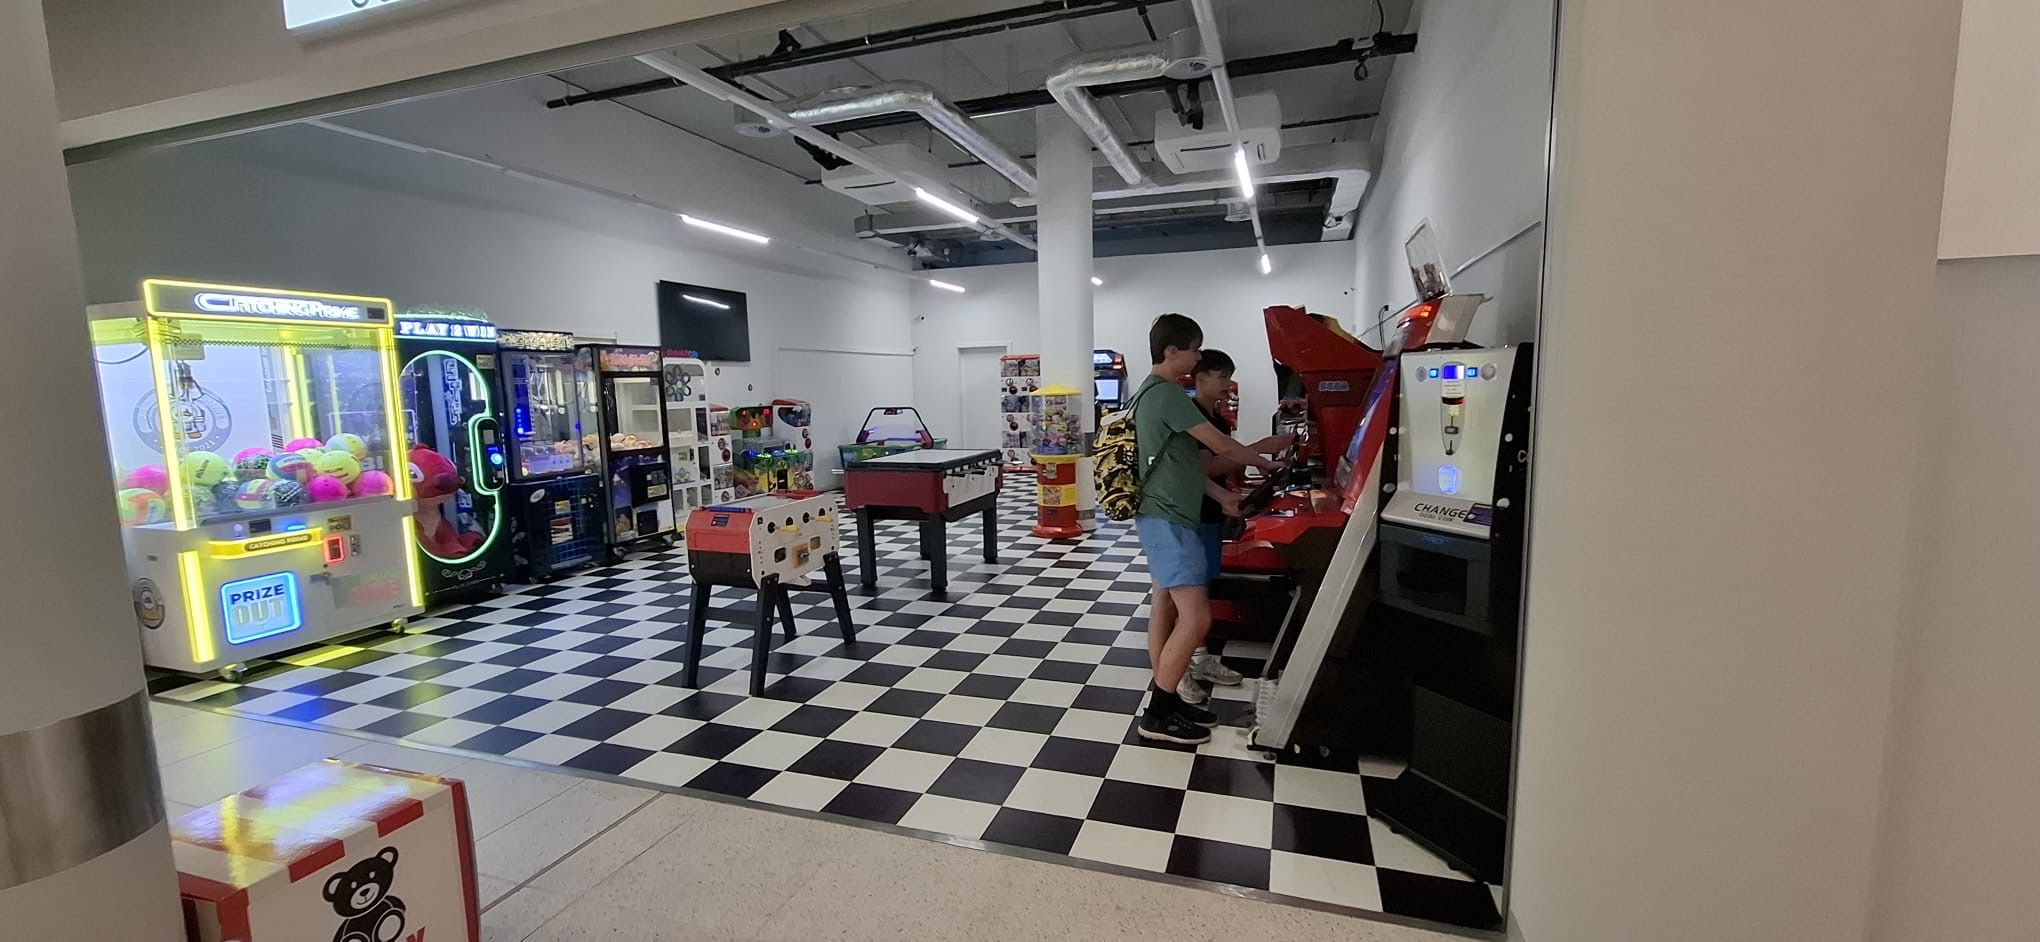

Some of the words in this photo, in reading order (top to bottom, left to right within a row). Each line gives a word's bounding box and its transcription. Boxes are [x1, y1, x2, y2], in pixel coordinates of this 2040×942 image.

[400, 321, 449, 337] PLAY
[450, 323, 463, 337] 2
[463, 325, 495, 338] WIN
[1414, 502, 1468, 519] CHANGE
[249, 538, 286, 550] CATCHING
[230, 583, 285, 605] PRIZE
[233, 598, 284, 627] OUT
